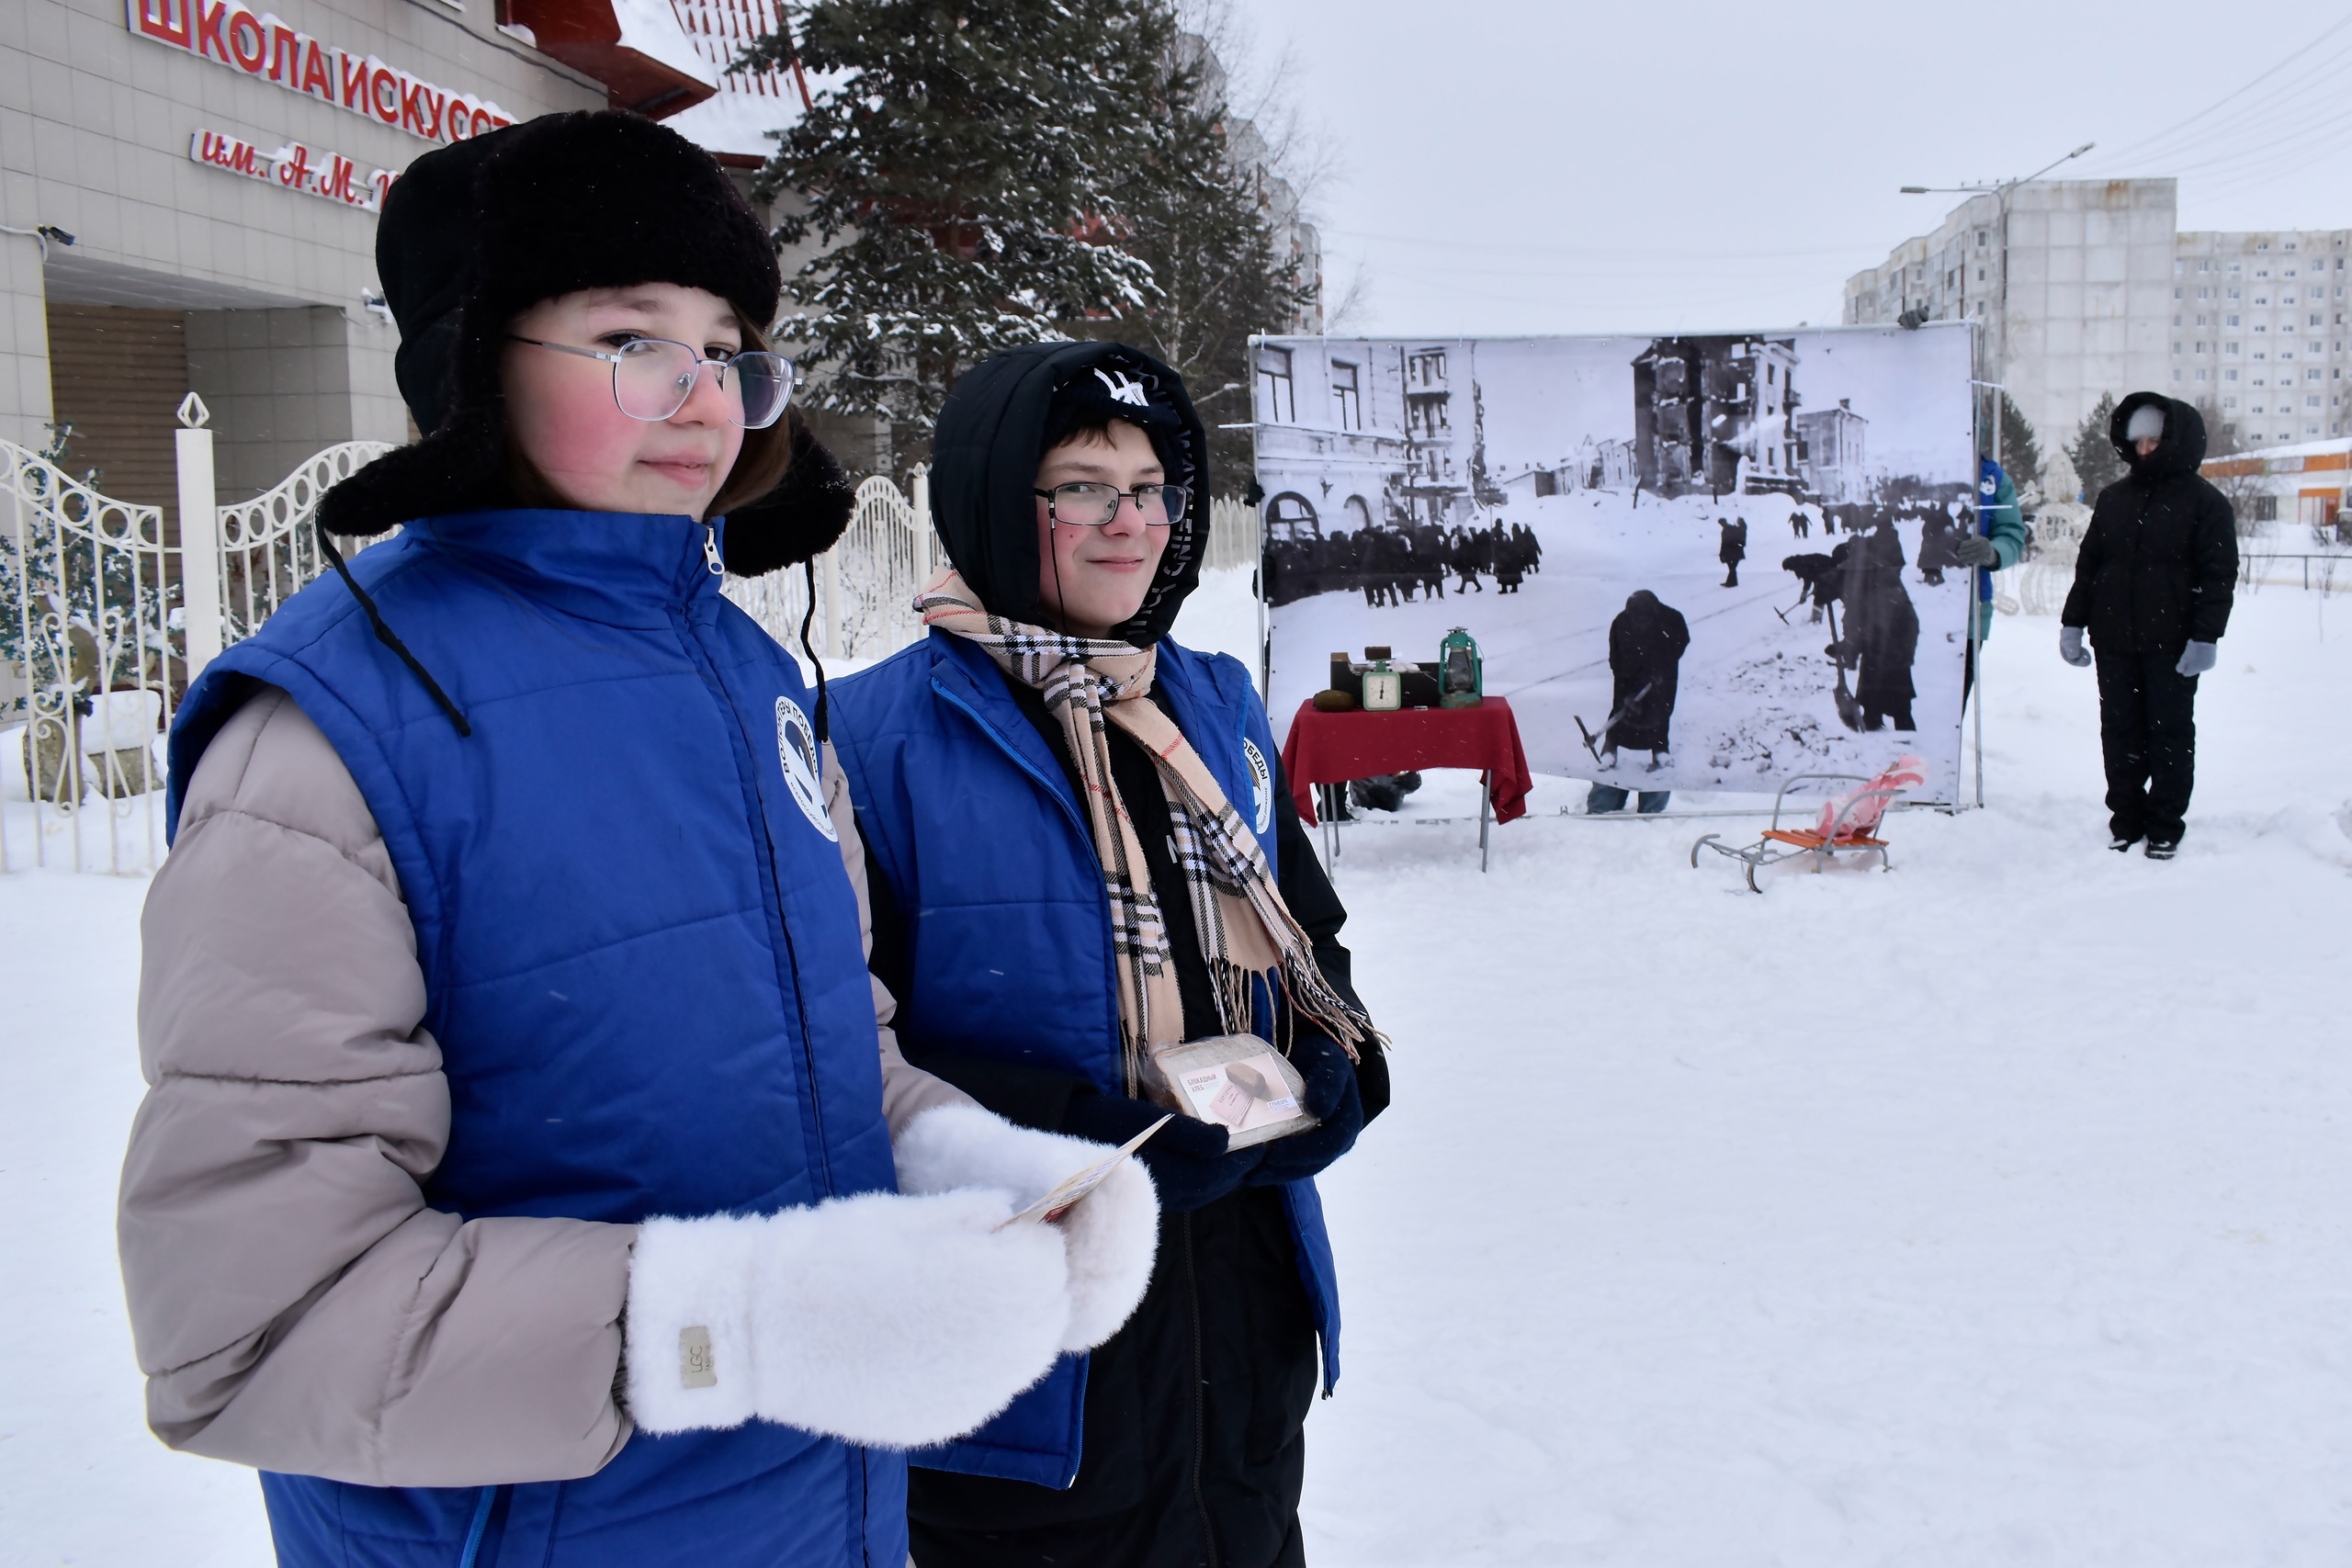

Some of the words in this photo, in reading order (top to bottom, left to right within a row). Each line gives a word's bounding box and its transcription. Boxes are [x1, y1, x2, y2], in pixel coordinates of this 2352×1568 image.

[139, 0, 332, 100] ШКОЛА
[341, 52, 511, 142] ИСКУСС
[202, 131, 266, 178] им.
[1243, 740, 1268, 780] ОБЕДЫ
